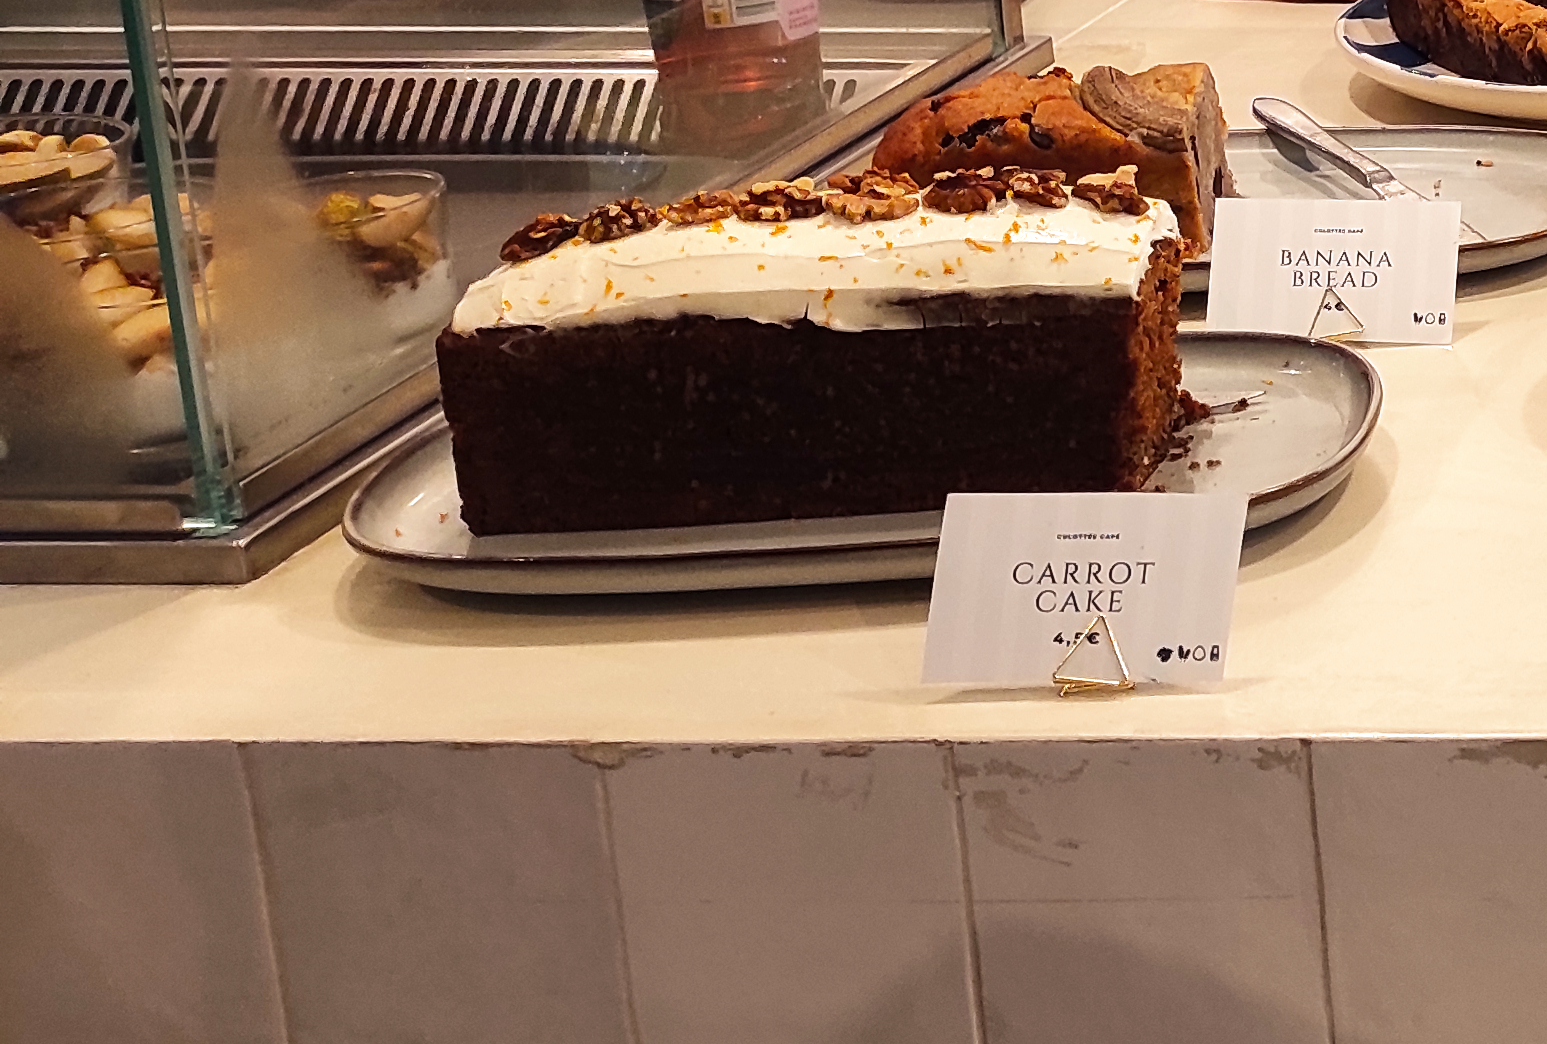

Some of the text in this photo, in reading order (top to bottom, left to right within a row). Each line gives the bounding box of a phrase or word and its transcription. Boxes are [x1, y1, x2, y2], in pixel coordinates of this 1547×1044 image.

[1280, 249, 1392, 268] BANANA
[1292, 270, 1378, 288] BREAD
[1012, 561, 1156, 585] CARROT
[1035, 589, 1124, 613] CAKE
